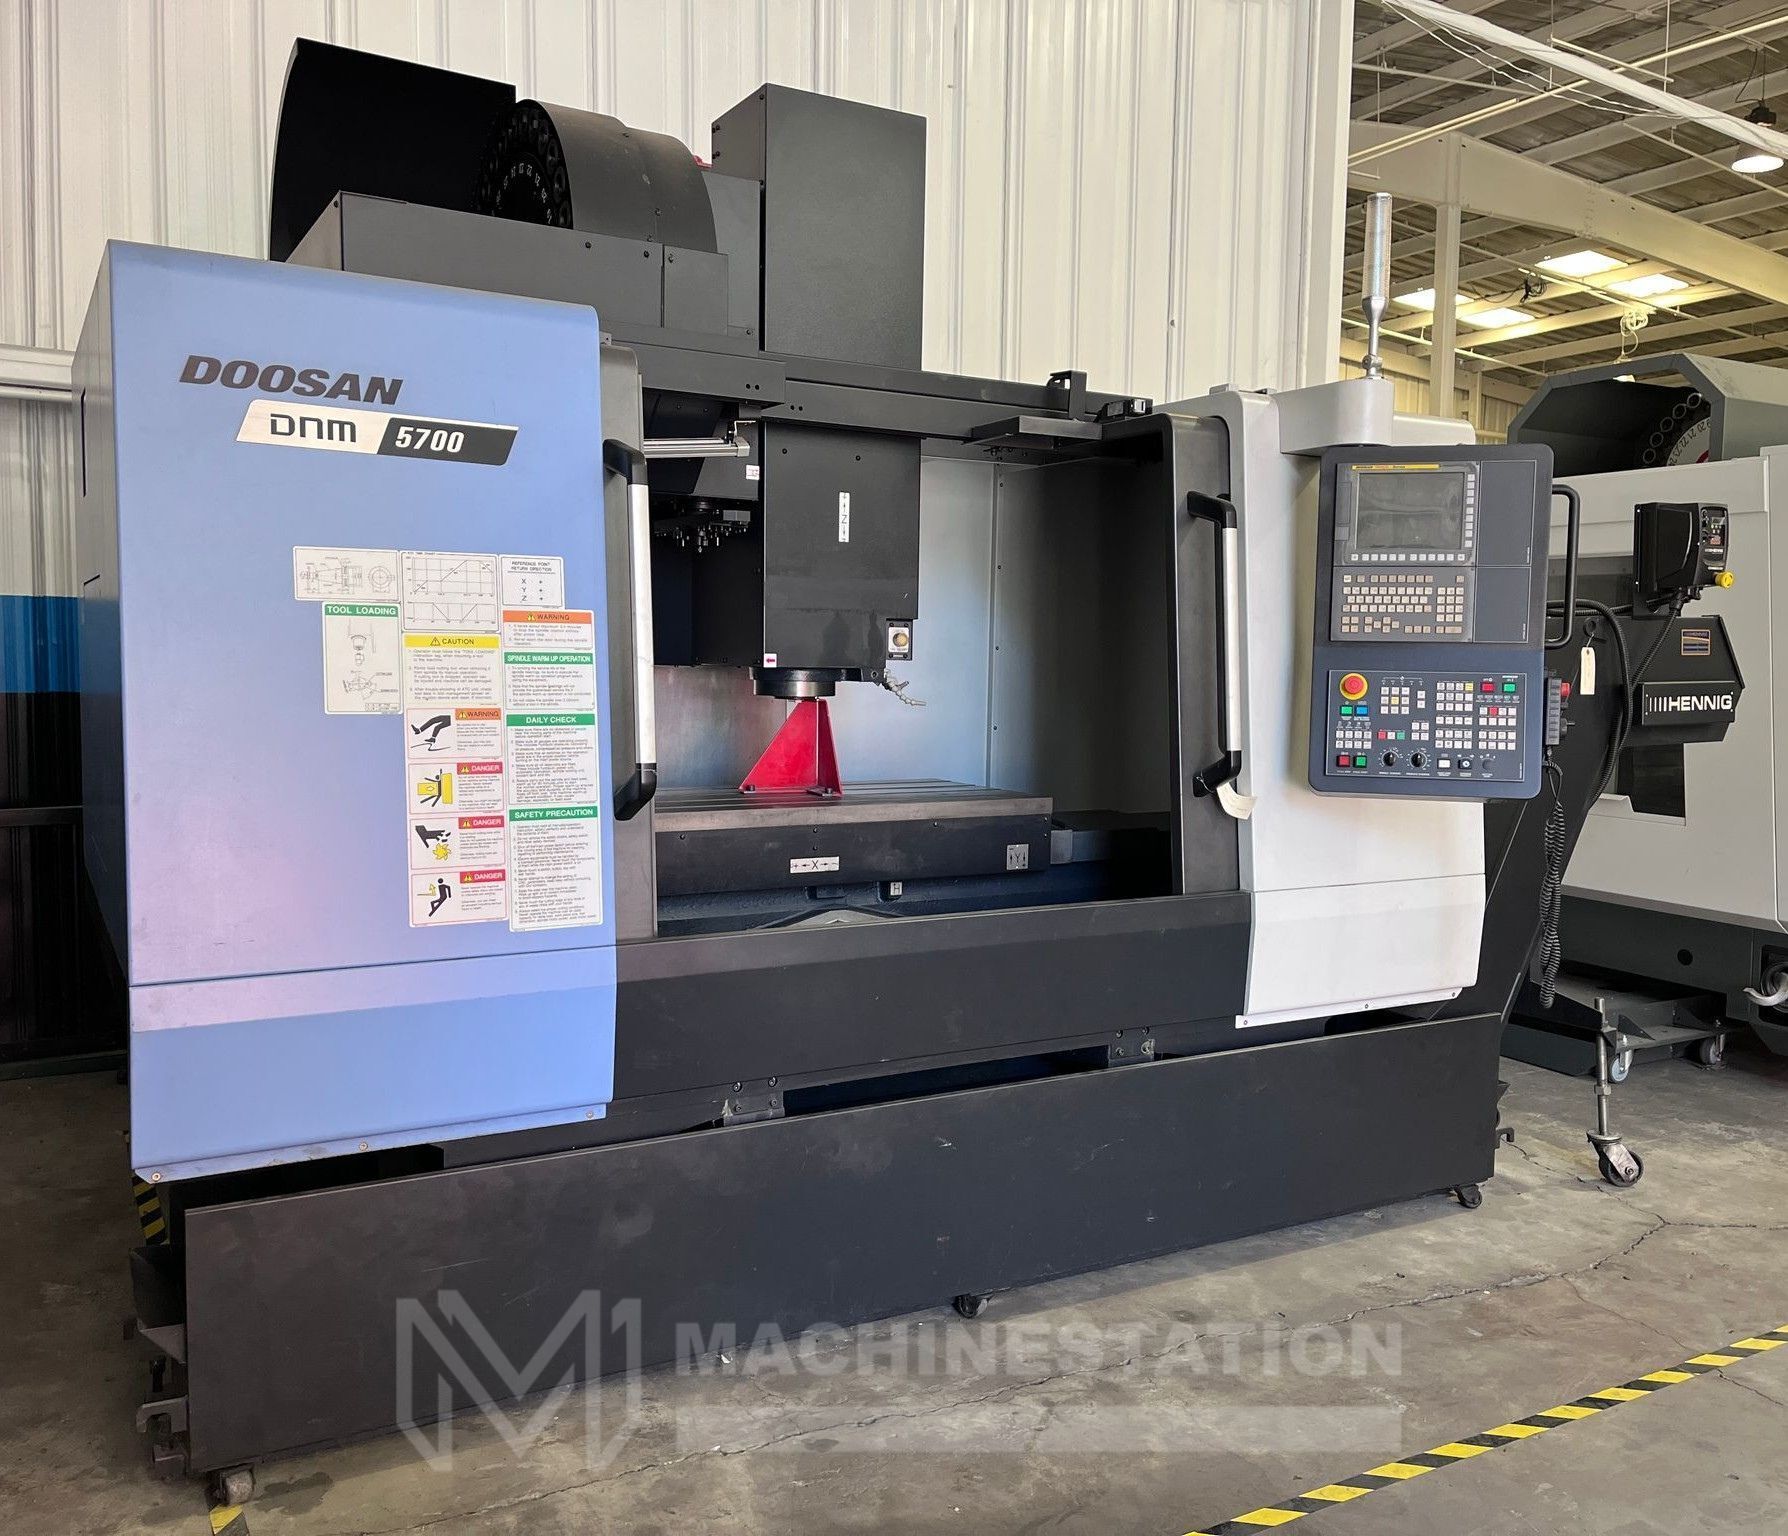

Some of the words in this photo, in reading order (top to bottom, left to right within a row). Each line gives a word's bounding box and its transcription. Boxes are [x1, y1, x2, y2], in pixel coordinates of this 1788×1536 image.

[179, 355, 403, 405] DOOSAN
[395, 427, 465, 453] 5700
[327, 606, 351, 614] TOOL
[356, 606, 397, 616] LOADING
[1668, 694, 1732, 712] HENNIG
[515, 811, 544, 819] SAFETY
[546, 809, 593, 817] PRECAUTION
